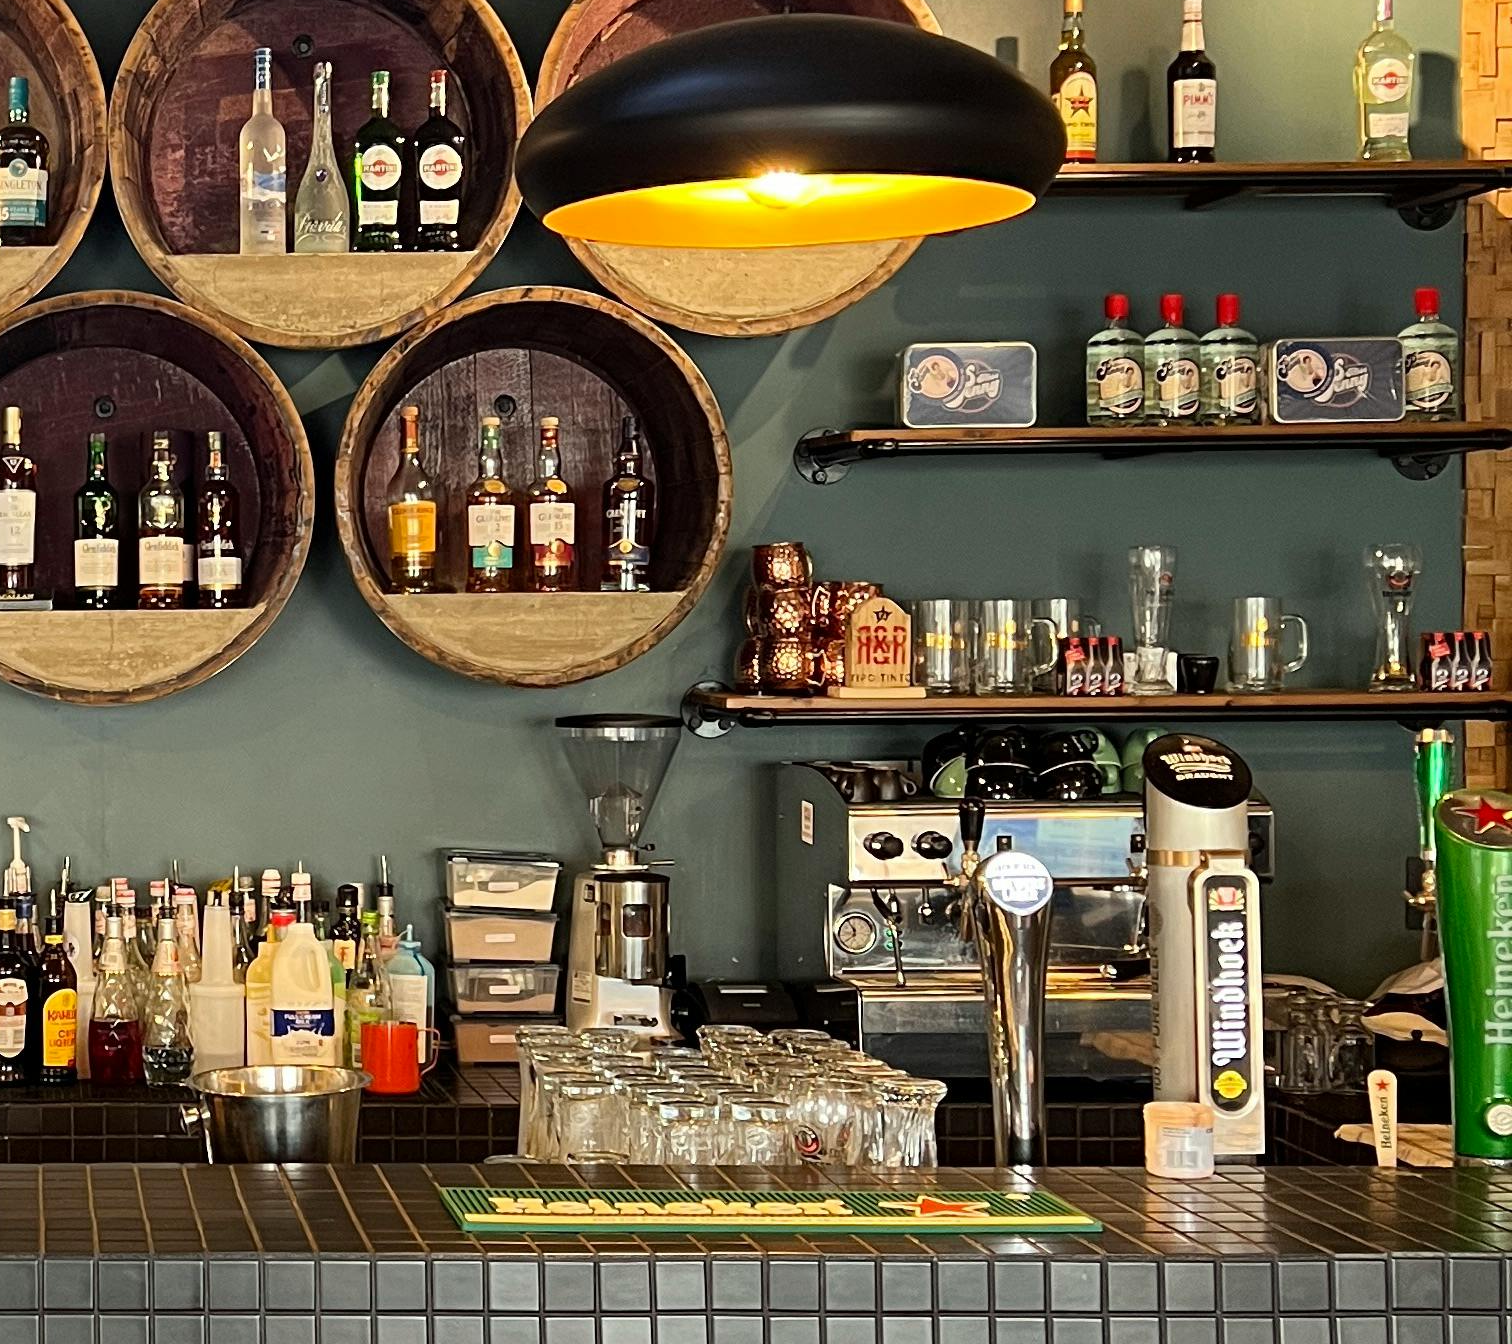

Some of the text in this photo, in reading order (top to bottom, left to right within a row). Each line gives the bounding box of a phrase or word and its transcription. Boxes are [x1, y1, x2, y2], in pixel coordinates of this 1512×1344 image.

[1183, 92, 1215, 106] PIMM'S
[9, 526, 22, 536] 12
[1159, 752, 1233, 766] Windhoek
[1175, 772, 1234, 781] DRAUGHT
[1484, 874, 1512, 1044] Heineken
[1211, 920, 1247, 1067] Windhoek
[1380, 1095, 1393, 1150] Heineken
